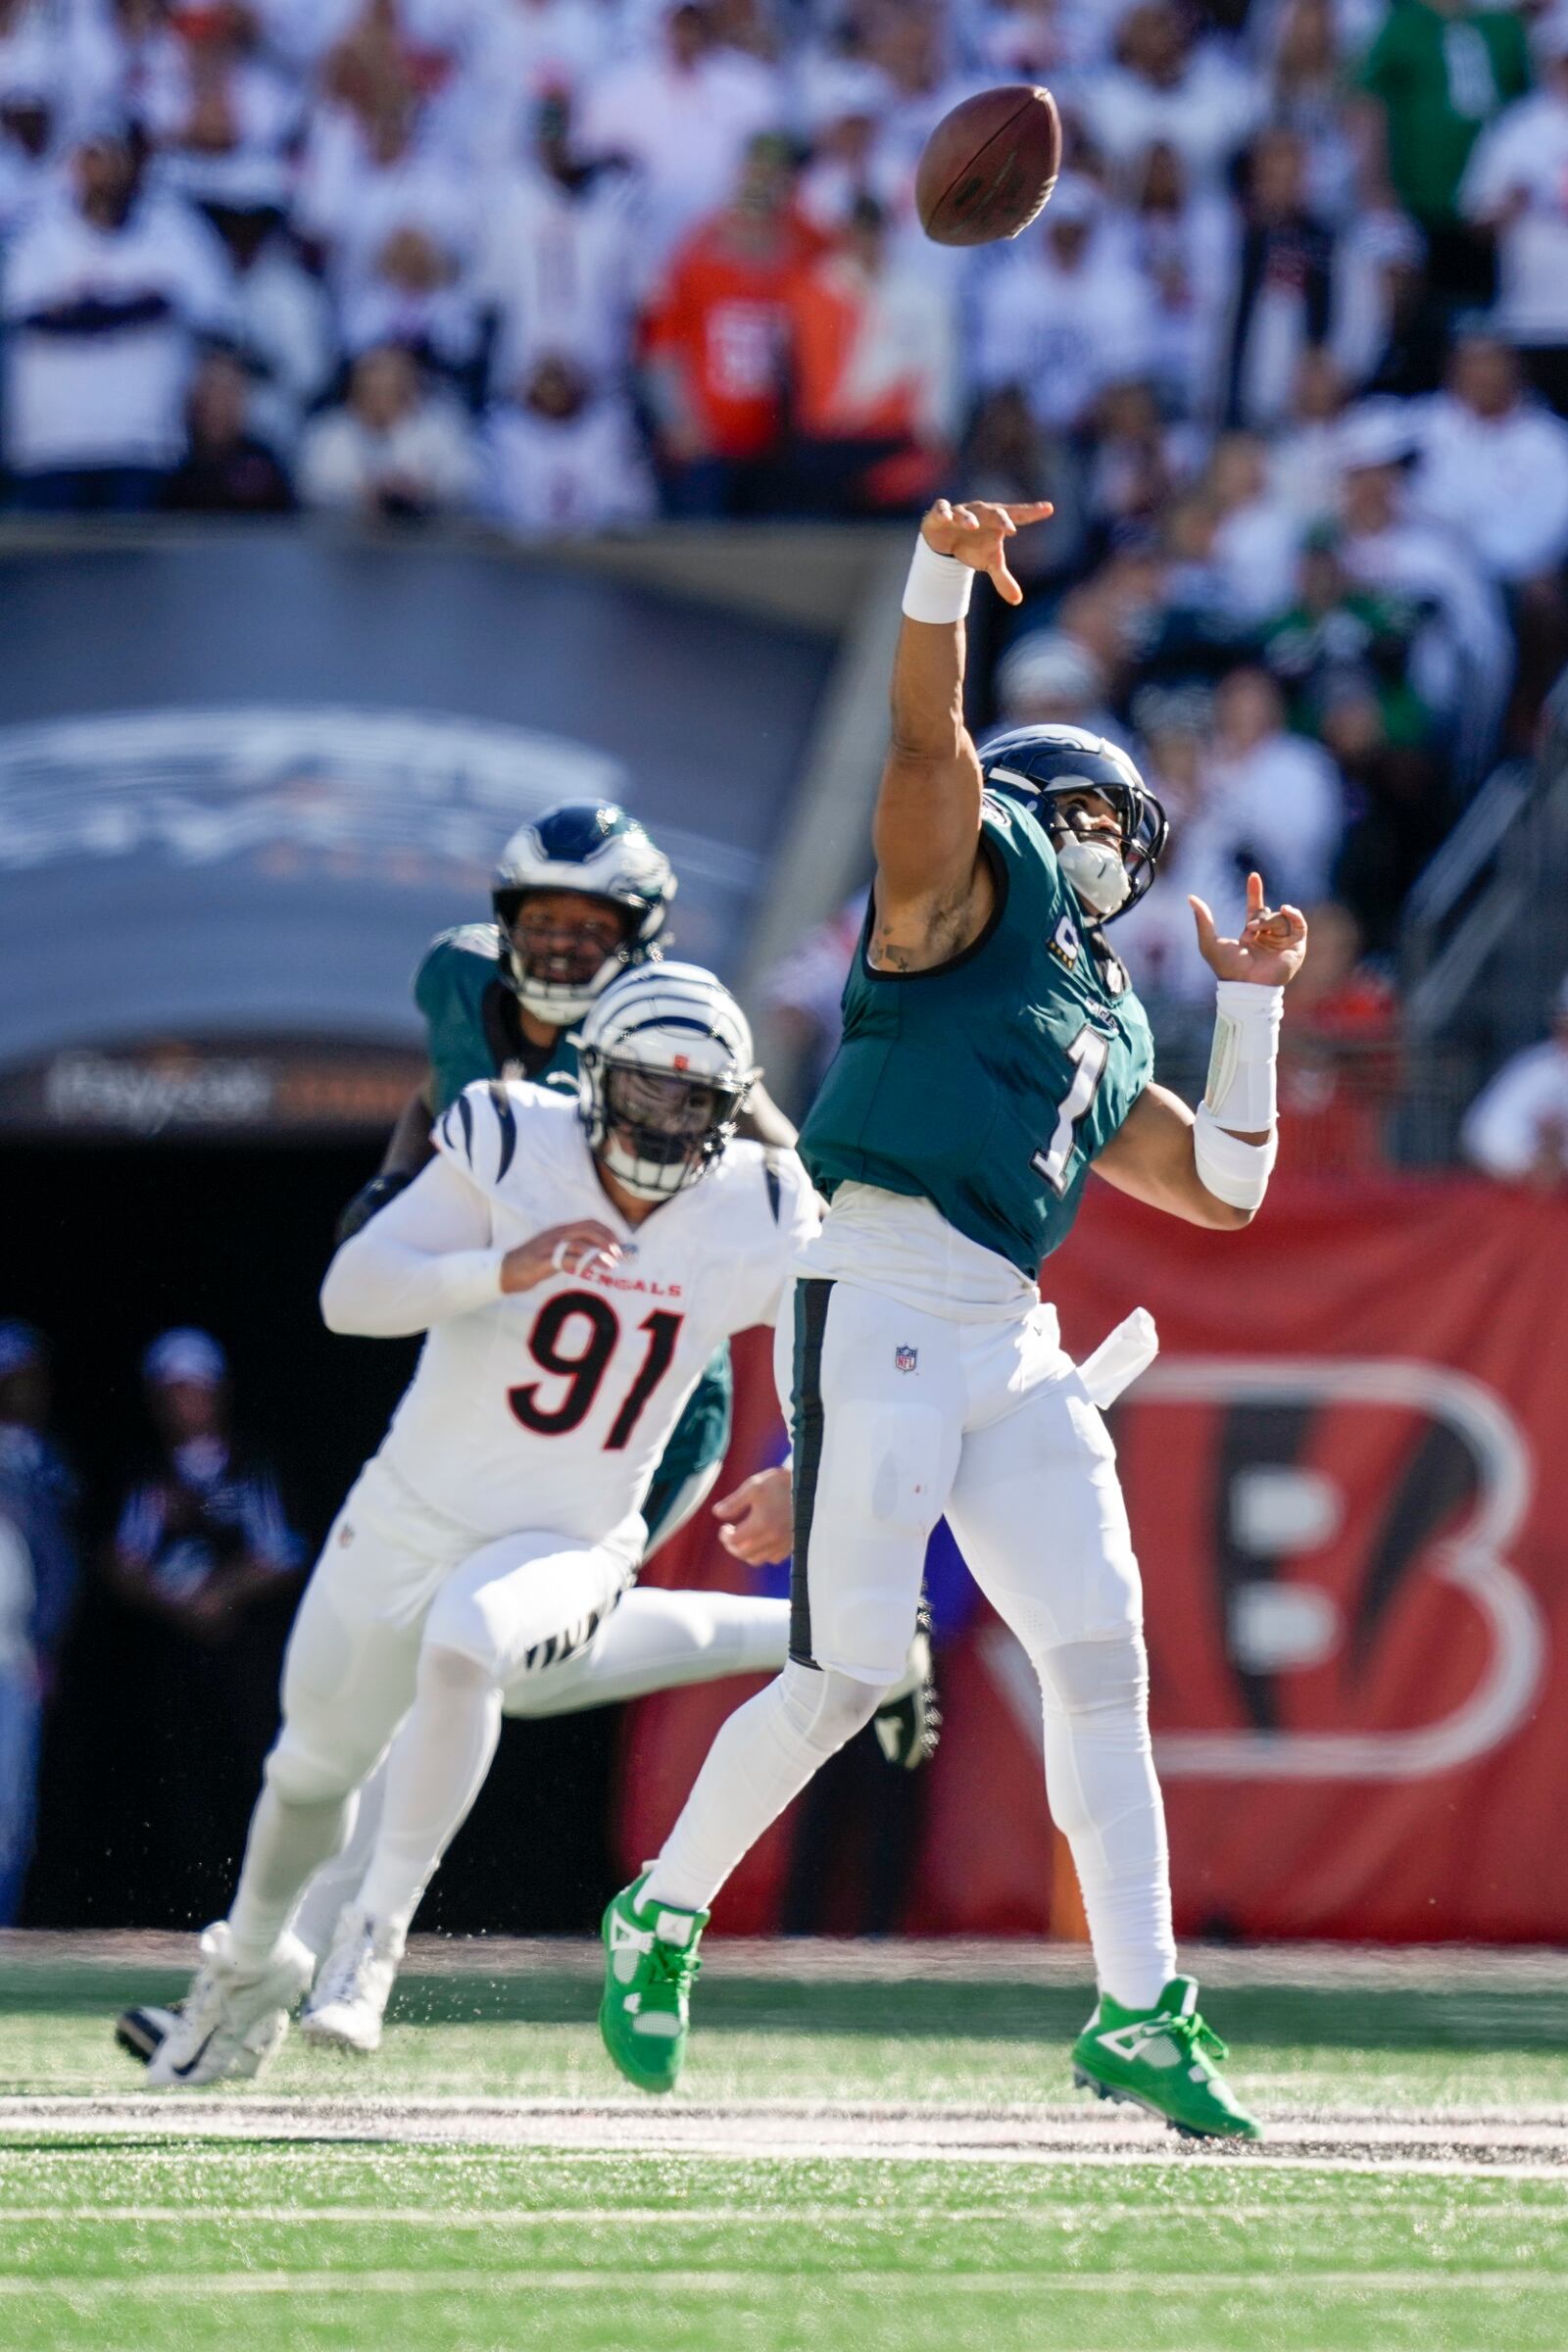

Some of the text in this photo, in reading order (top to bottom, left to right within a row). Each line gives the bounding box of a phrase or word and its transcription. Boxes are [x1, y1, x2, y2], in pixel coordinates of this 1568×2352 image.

[1030, 1024, 1109, 1200] 1
[564, 1263, 683, 1298] ENGALS
[507, 1288, 685, 1452] 91
